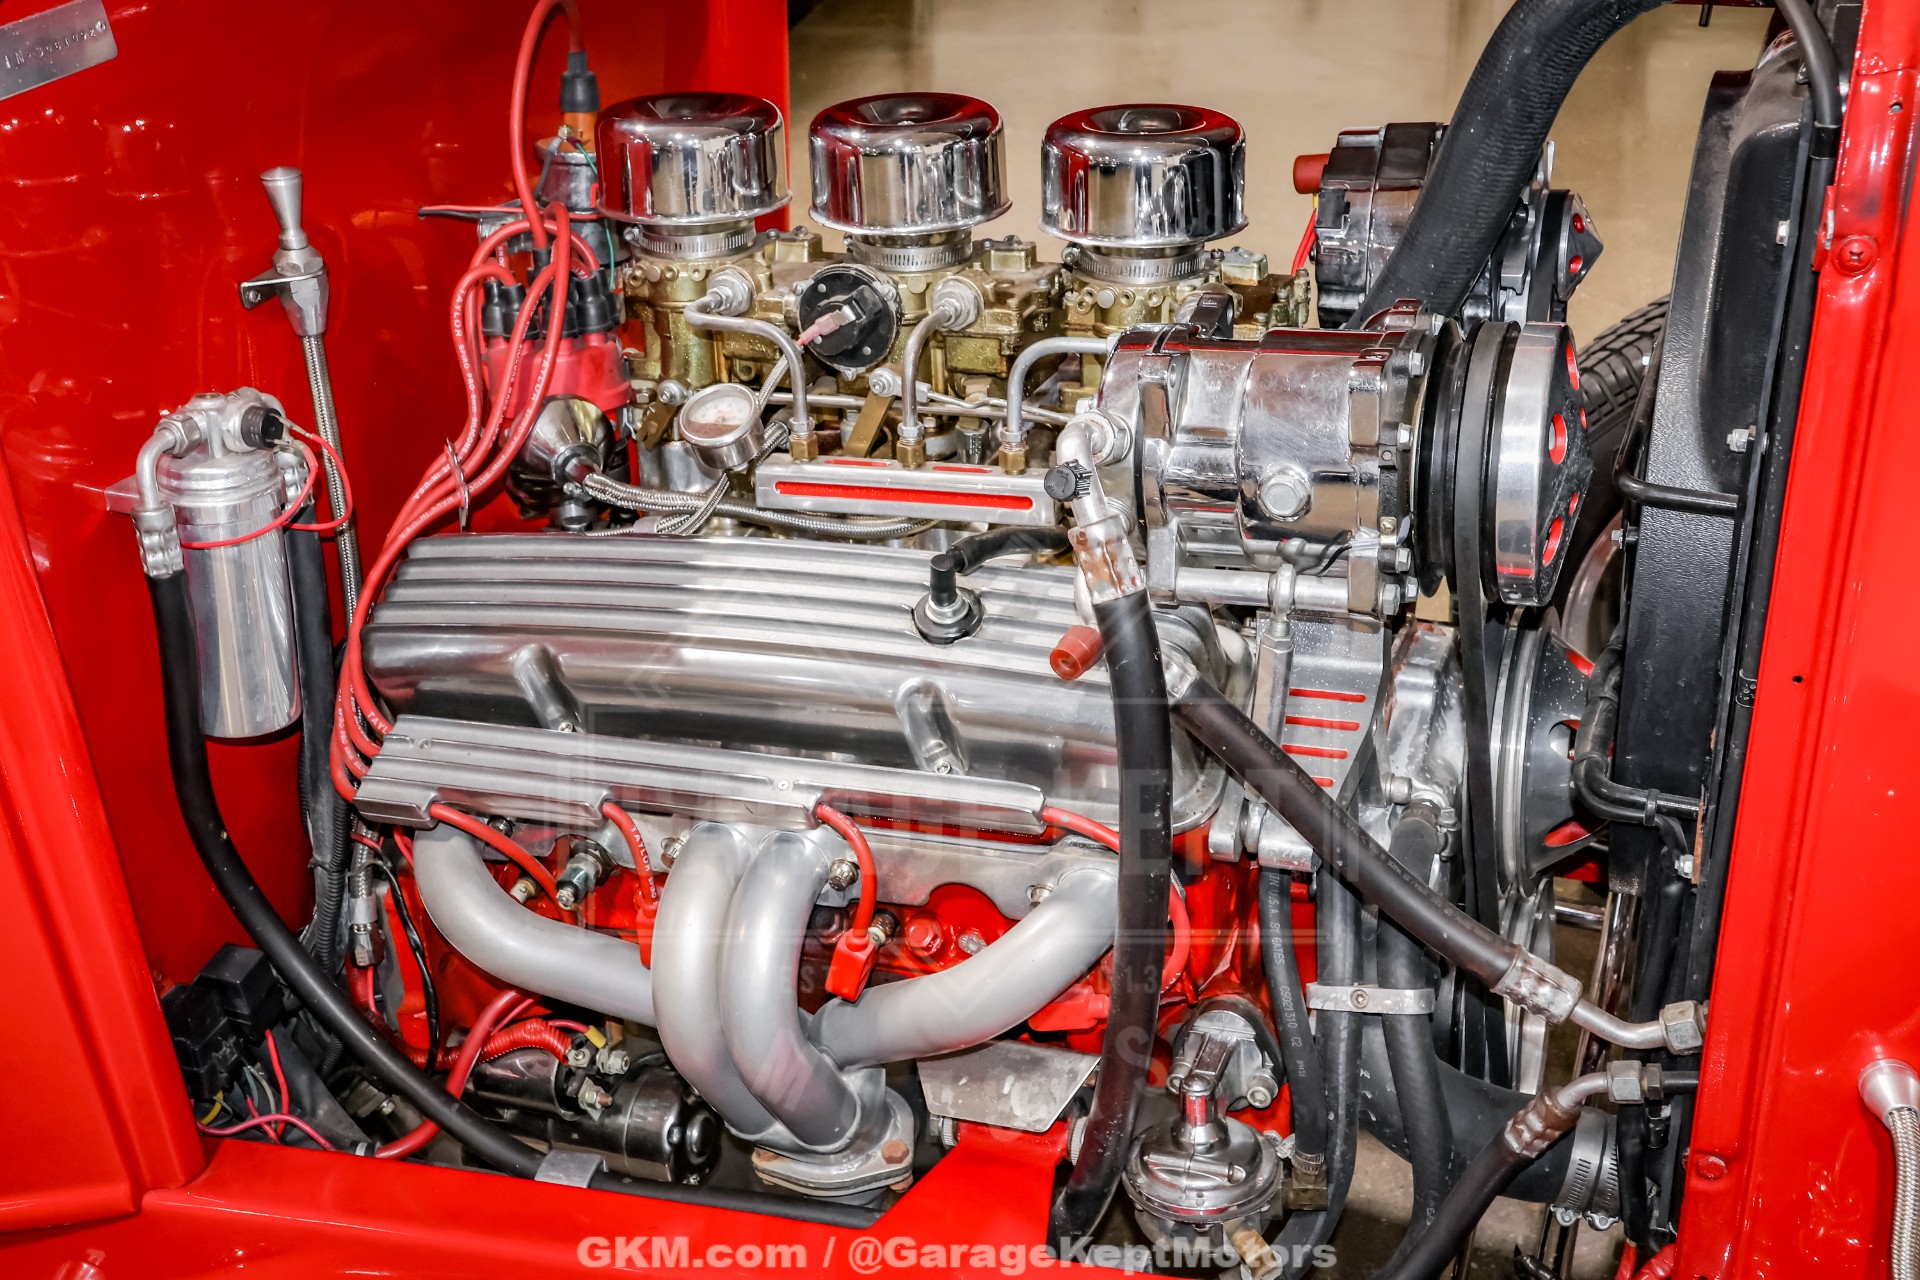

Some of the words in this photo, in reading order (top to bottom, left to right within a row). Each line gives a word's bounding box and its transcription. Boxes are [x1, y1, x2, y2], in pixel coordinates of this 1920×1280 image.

[453, 288, 466, 337] TAYLOR
[458, 344, 470, 369] SPIRO
[530, 353, 552, 402] TAYLOR
[630, 824, 652, 872] TAYLOR
[1270, 922, 1281, 935] BY
[1271, 936, 1286, 965] GATES
